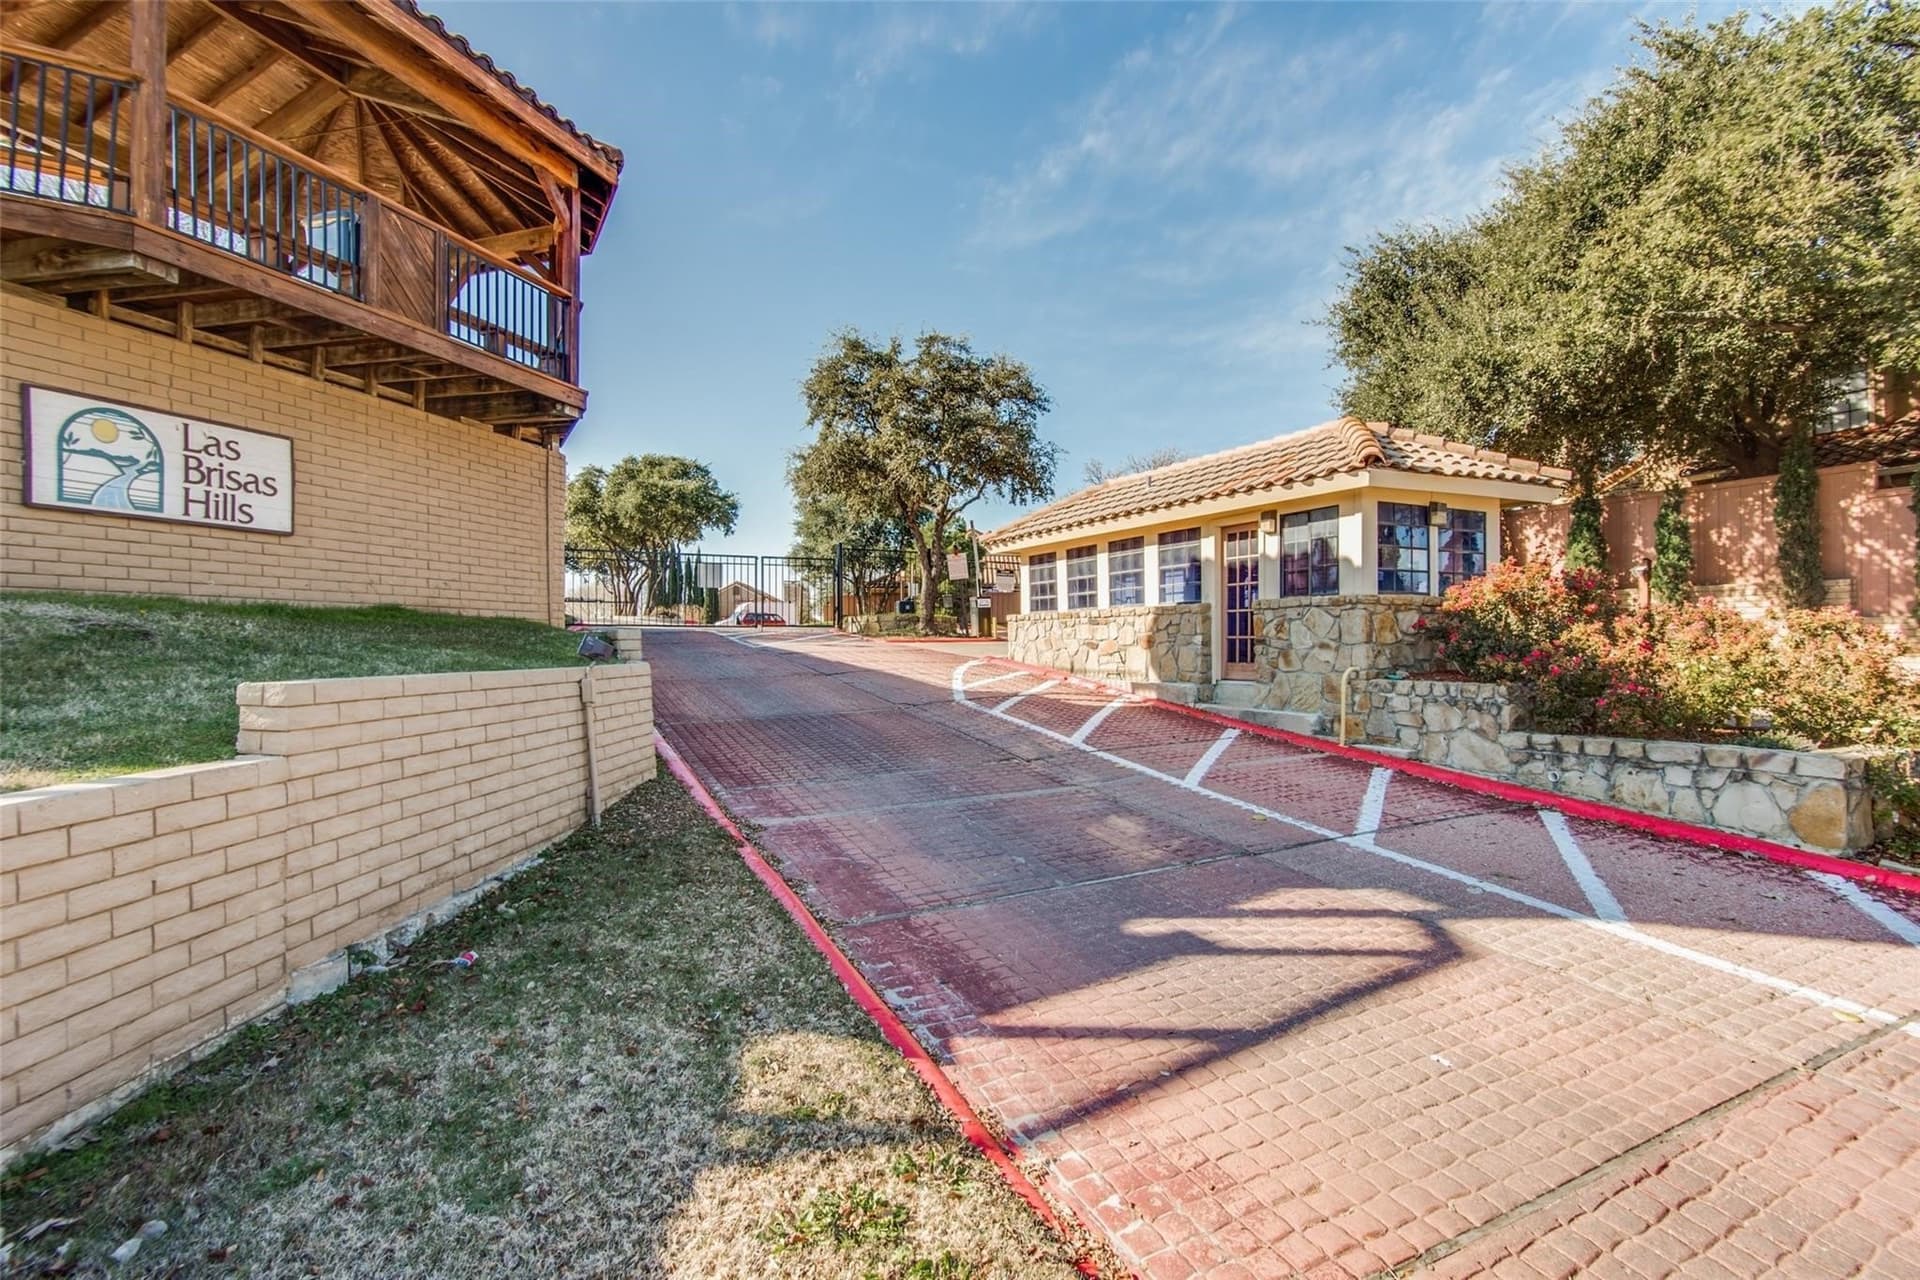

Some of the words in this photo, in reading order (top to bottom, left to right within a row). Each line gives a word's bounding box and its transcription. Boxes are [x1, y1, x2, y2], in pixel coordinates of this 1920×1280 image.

[182, 423, 241, 461] Las
[182, 454, 278, 497] Brisas
[182, 487, 254, 524] Hills
